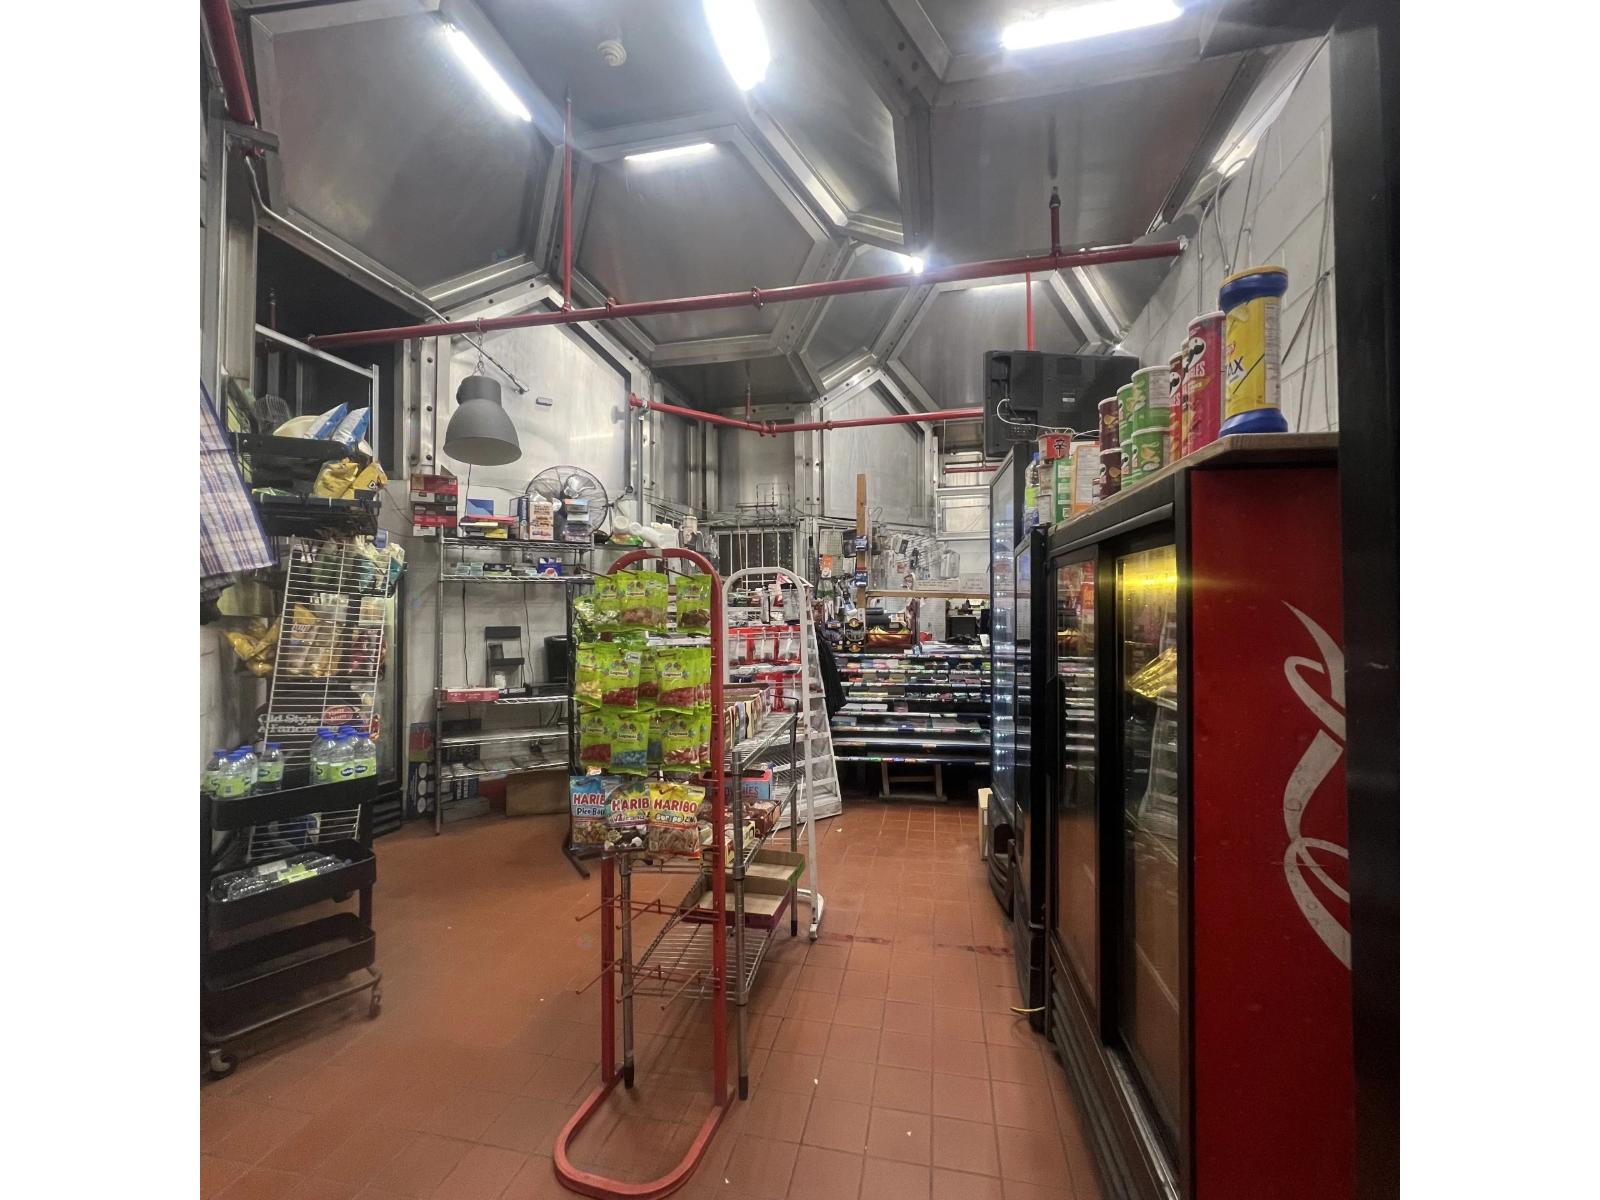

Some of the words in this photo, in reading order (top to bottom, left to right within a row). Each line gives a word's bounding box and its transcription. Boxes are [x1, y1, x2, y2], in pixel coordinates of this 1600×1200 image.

[573, 793, 605, 805] HARIB
[612, 798, 650, 811] HARIB
[654, 798, 697, 813] HARIBO
